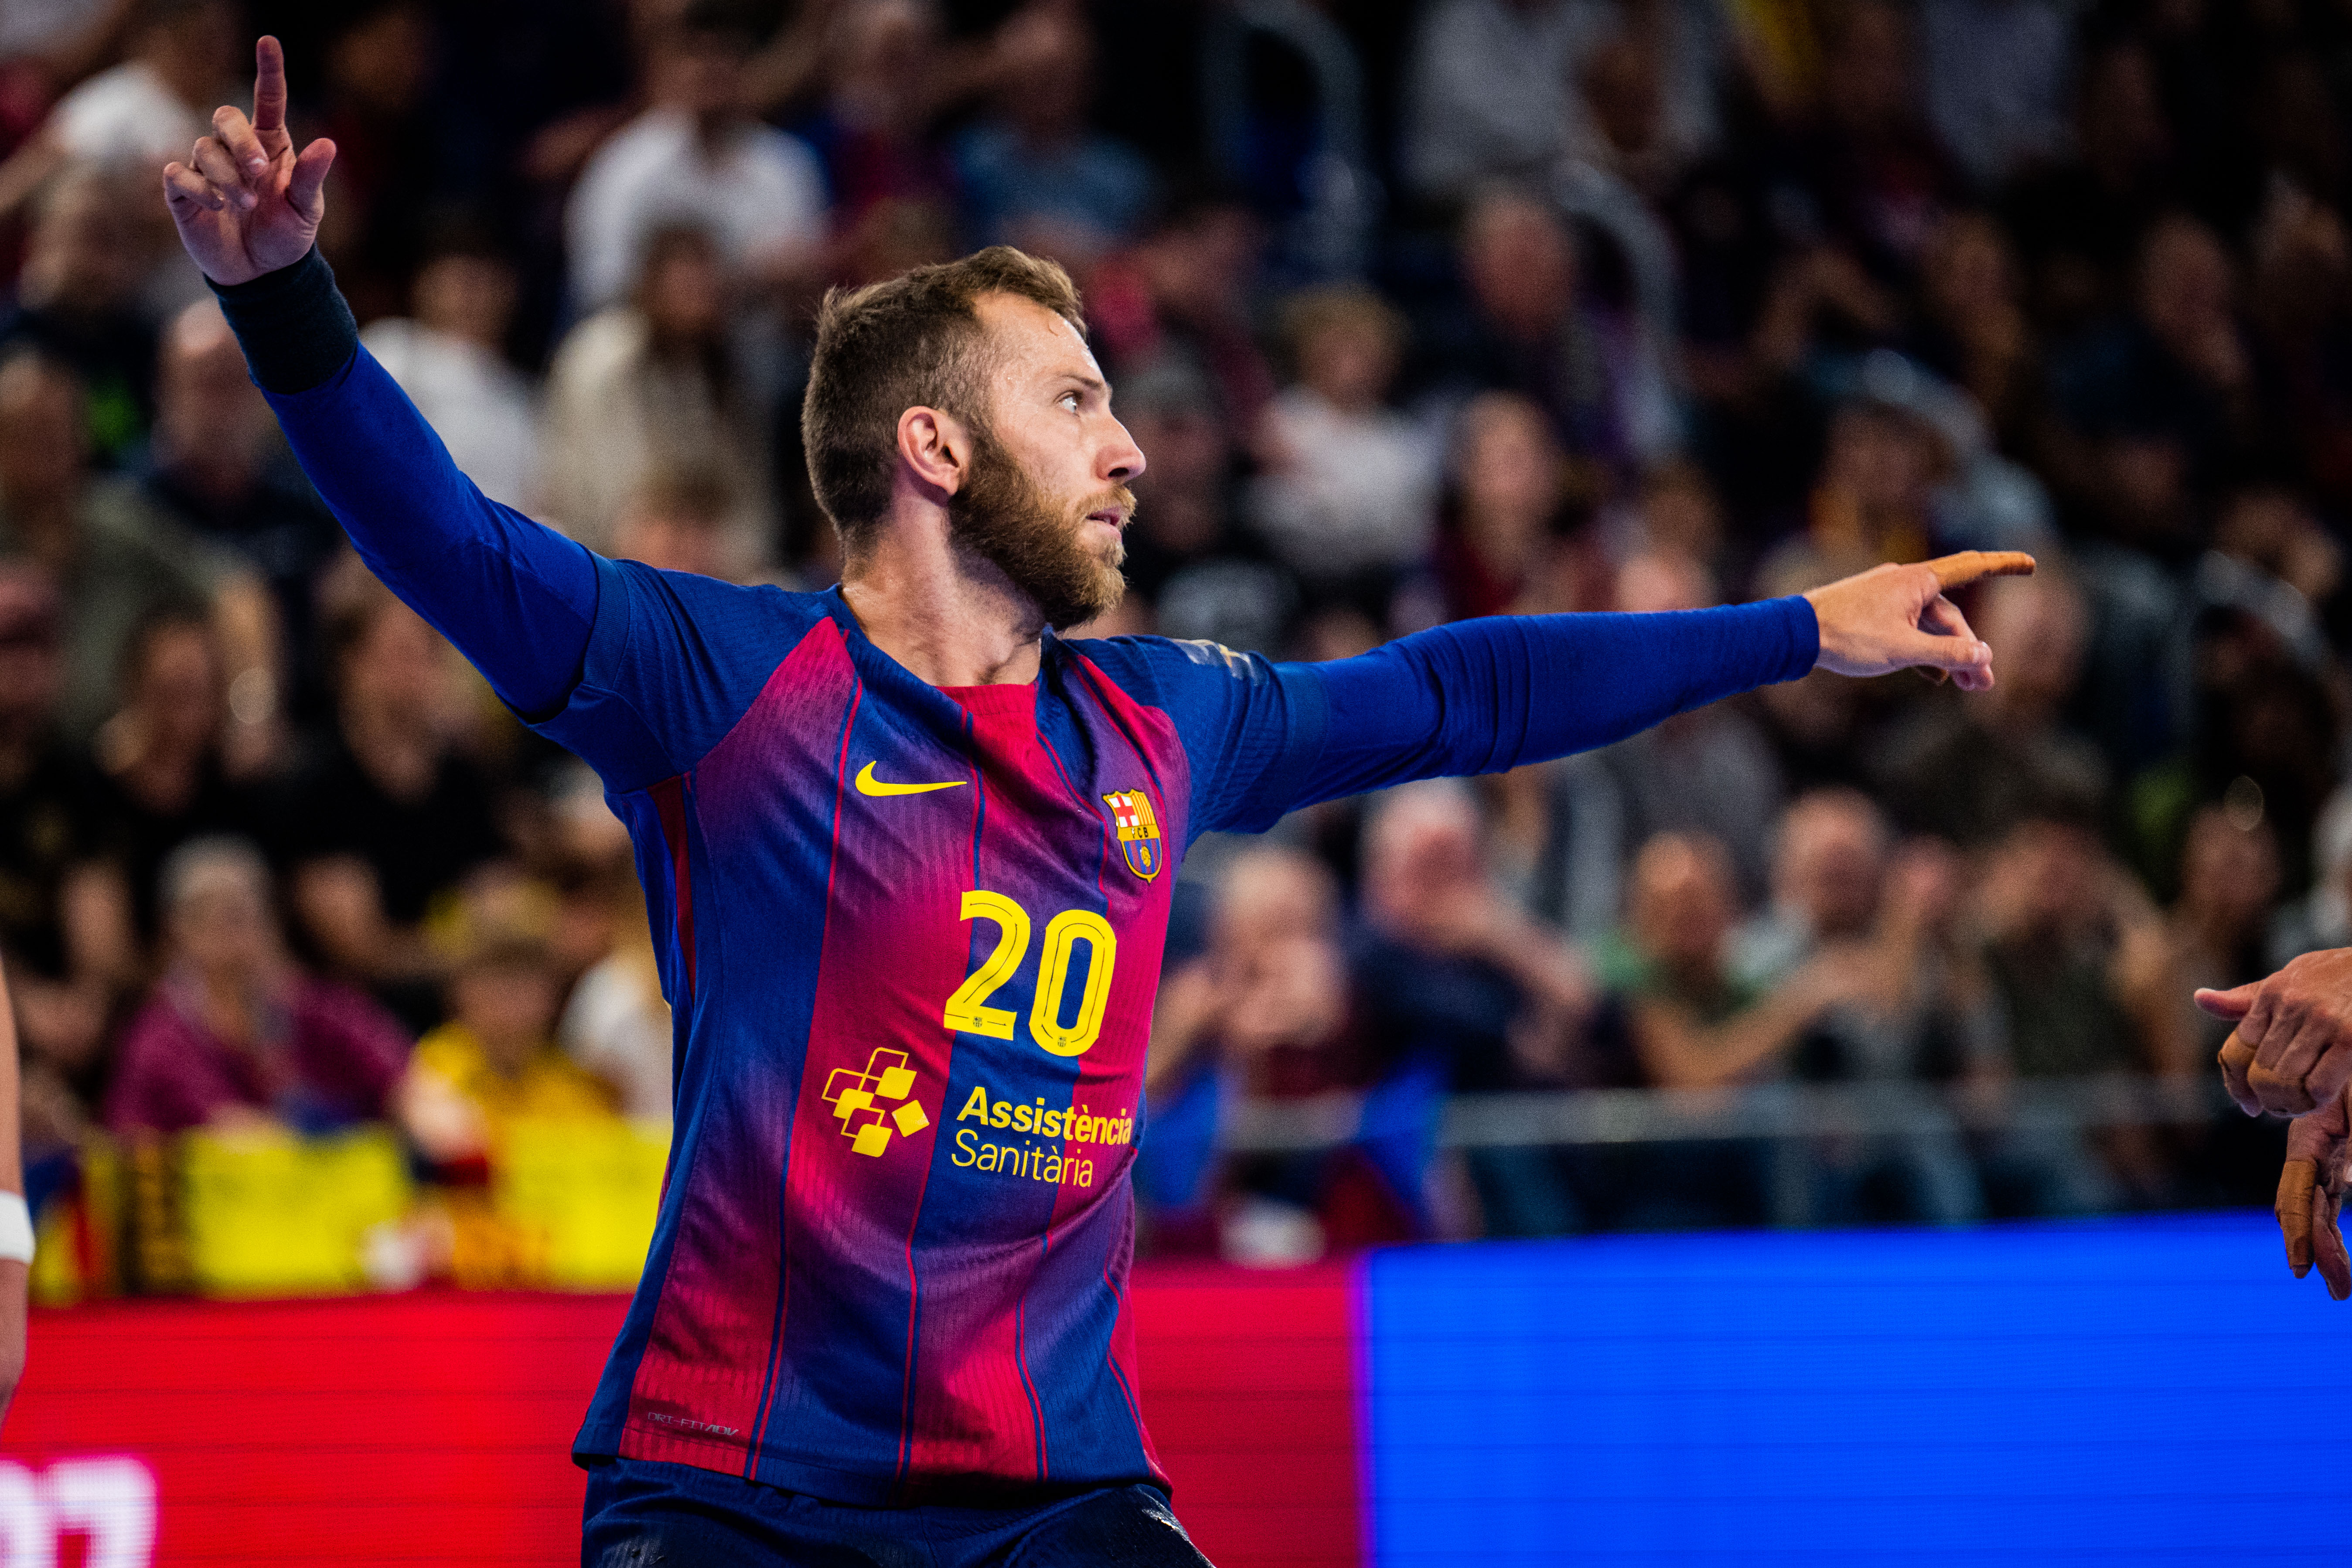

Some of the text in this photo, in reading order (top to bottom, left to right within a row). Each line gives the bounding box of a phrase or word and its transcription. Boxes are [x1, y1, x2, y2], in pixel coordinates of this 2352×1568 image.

[944, 890, 1118, 1057] 20
[957, 1086, 1132, 1145] Assistència
[951, 1128, 1094, 1188] Sanitària
